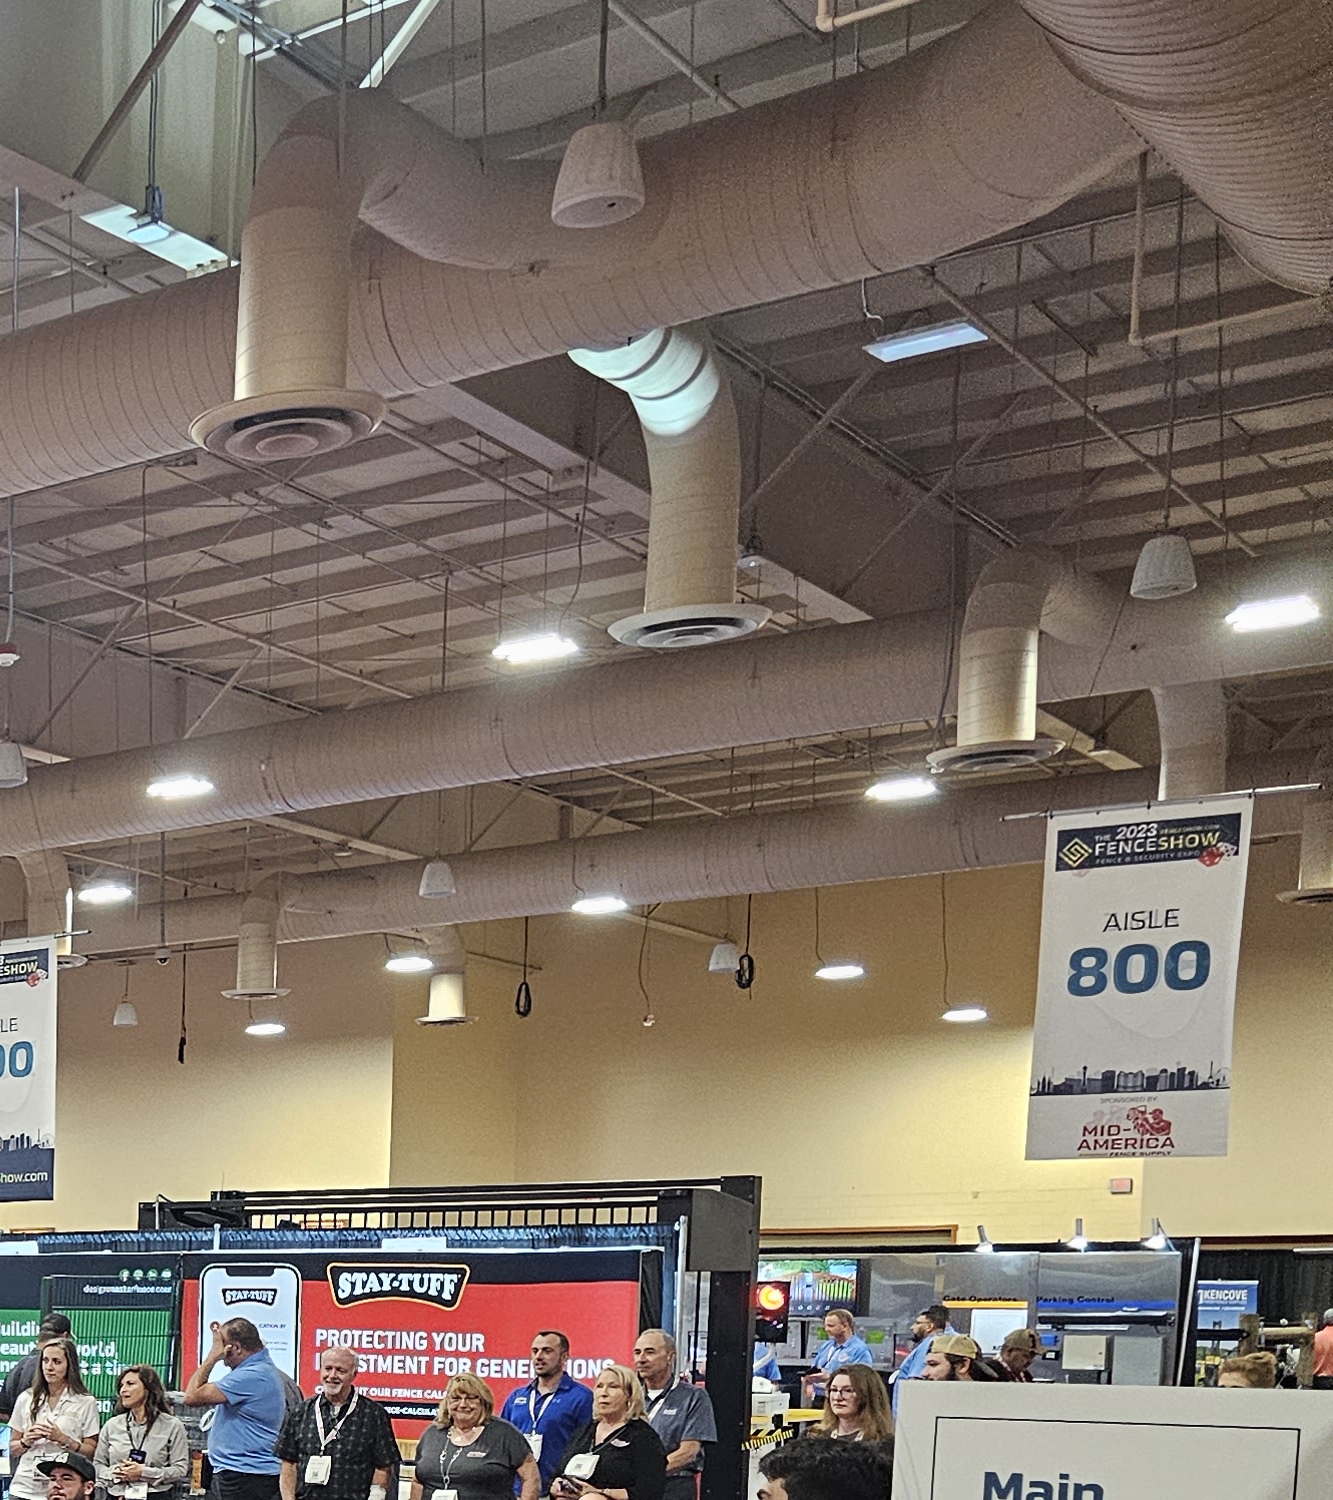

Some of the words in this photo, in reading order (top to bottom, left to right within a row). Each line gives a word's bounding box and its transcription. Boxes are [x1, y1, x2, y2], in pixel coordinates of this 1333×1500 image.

[1094, 834, 1111, 842] THE
[1115, 823, 1158, 840] 2023
[1094, 831, 1221, 857] FENCESHOW
[1095, 857, 1122, 865] FENCE
[1134, 852, 1175, 863] SECURITY
[1177, 850, 1200, 859] EXPO
[1102, 908, 1180, 933] AISLE
[1066, 939, 1211, 998] 800
[1083, 1125, 1131, 1137] MID-
[1077, 1136, 1175, 1151] AMERICA
[338, 1271, 459, 1300] STAY-TUFF
[225, 1290, 275, 1303] STAY-TUFF
[1036, 1296, 1074, 1304] Parking
[1077, 1296, 1115, 1304] Control
[1204, 1289, 1248, 1300] KENCOVE
[315, 1328, 428, 1350] PROTECTING
[431, 1332, 485, 1353] YOUR
[315, 1355, 429, 1375] ISTMENT
[433, 1357, 471, 1375] FOR
[476, 1358, 615, 1380] GENEIONS
[369, 1387, 391, 1398] OUR
[394, 1388, 423, 1399] FENCE
